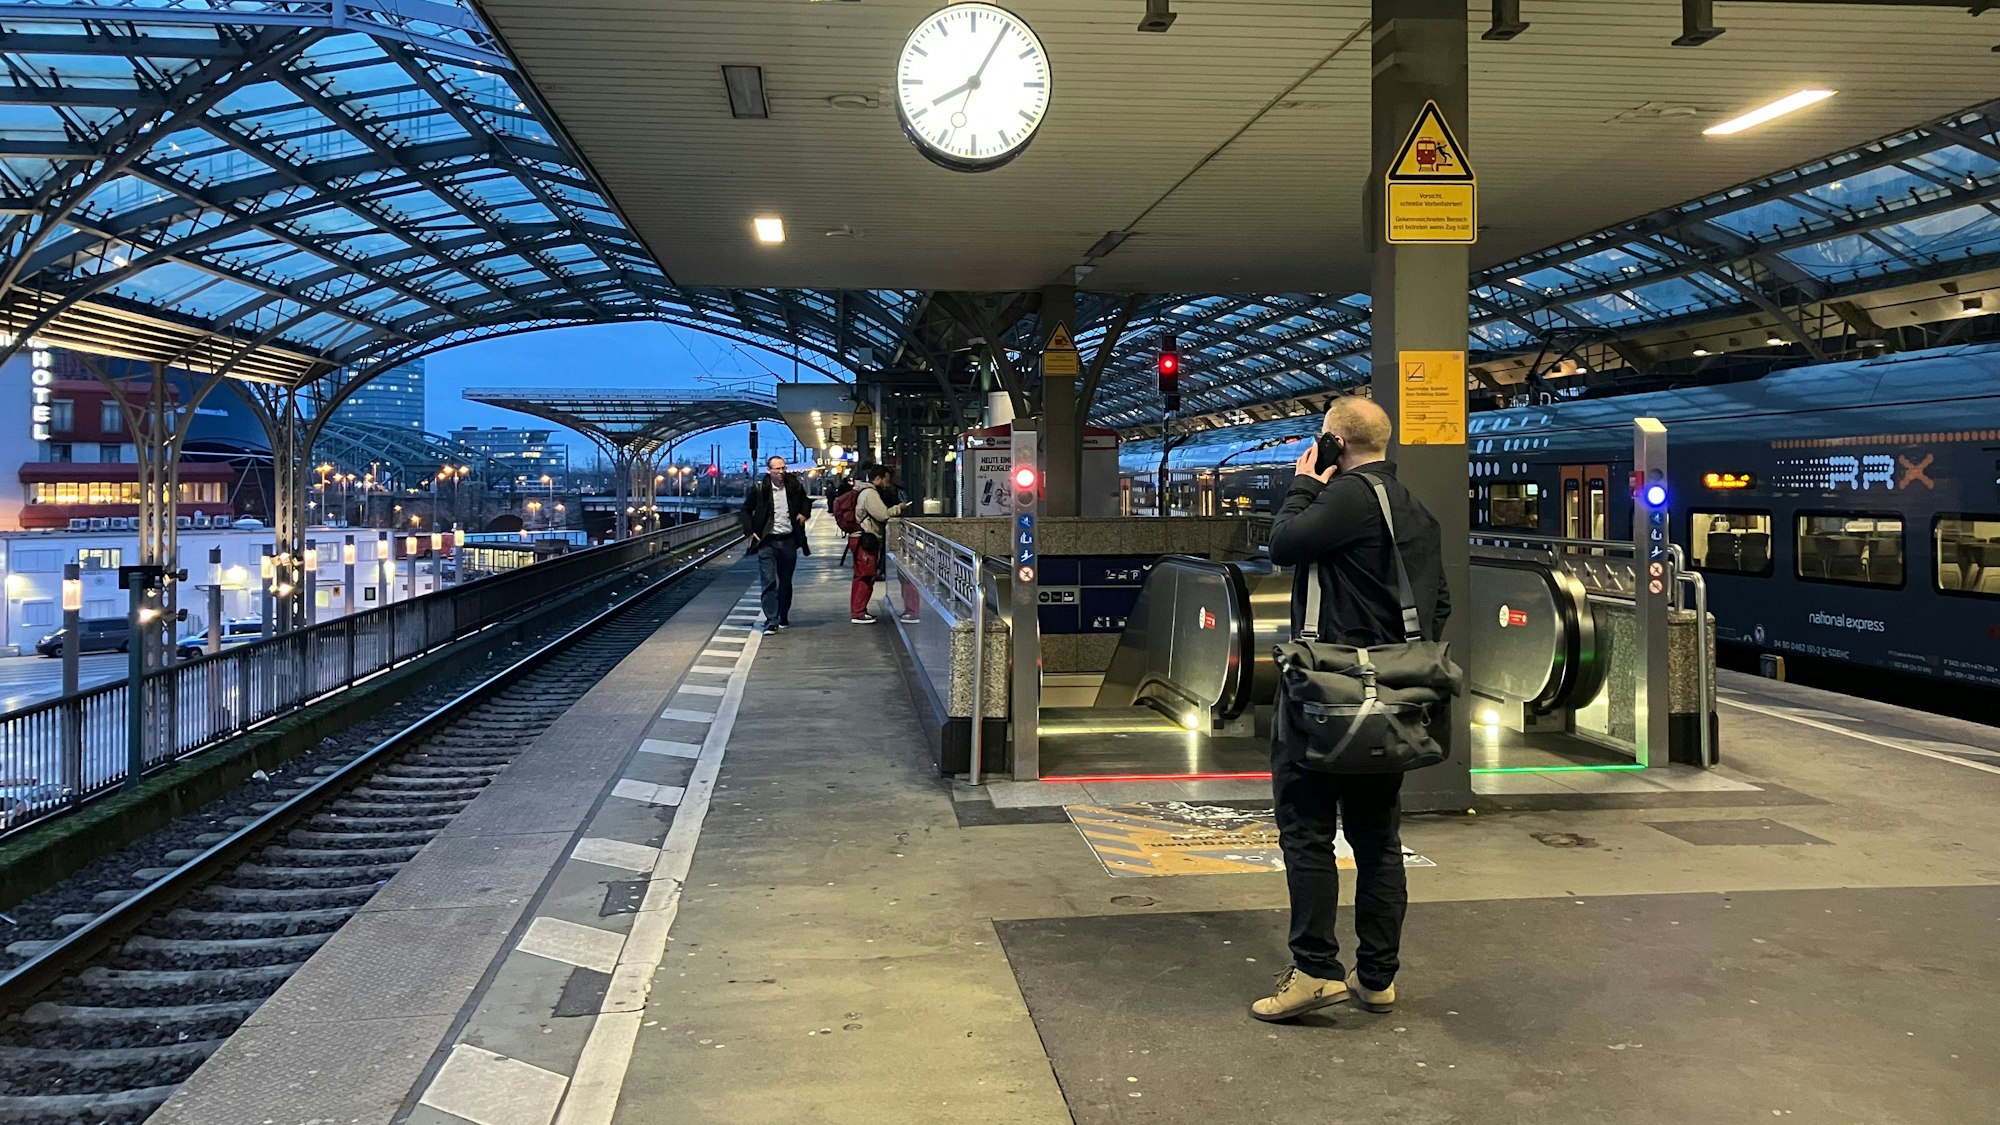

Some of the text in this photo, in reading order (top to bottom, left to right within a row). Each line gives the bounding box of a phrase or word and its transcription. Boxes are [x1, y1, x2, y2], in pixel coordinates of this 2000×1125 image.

[32, 351, 50, 440] HOTEL
[1830, 454, 1934, 490] RRX
[1808, 611, 1885, 632] national express
